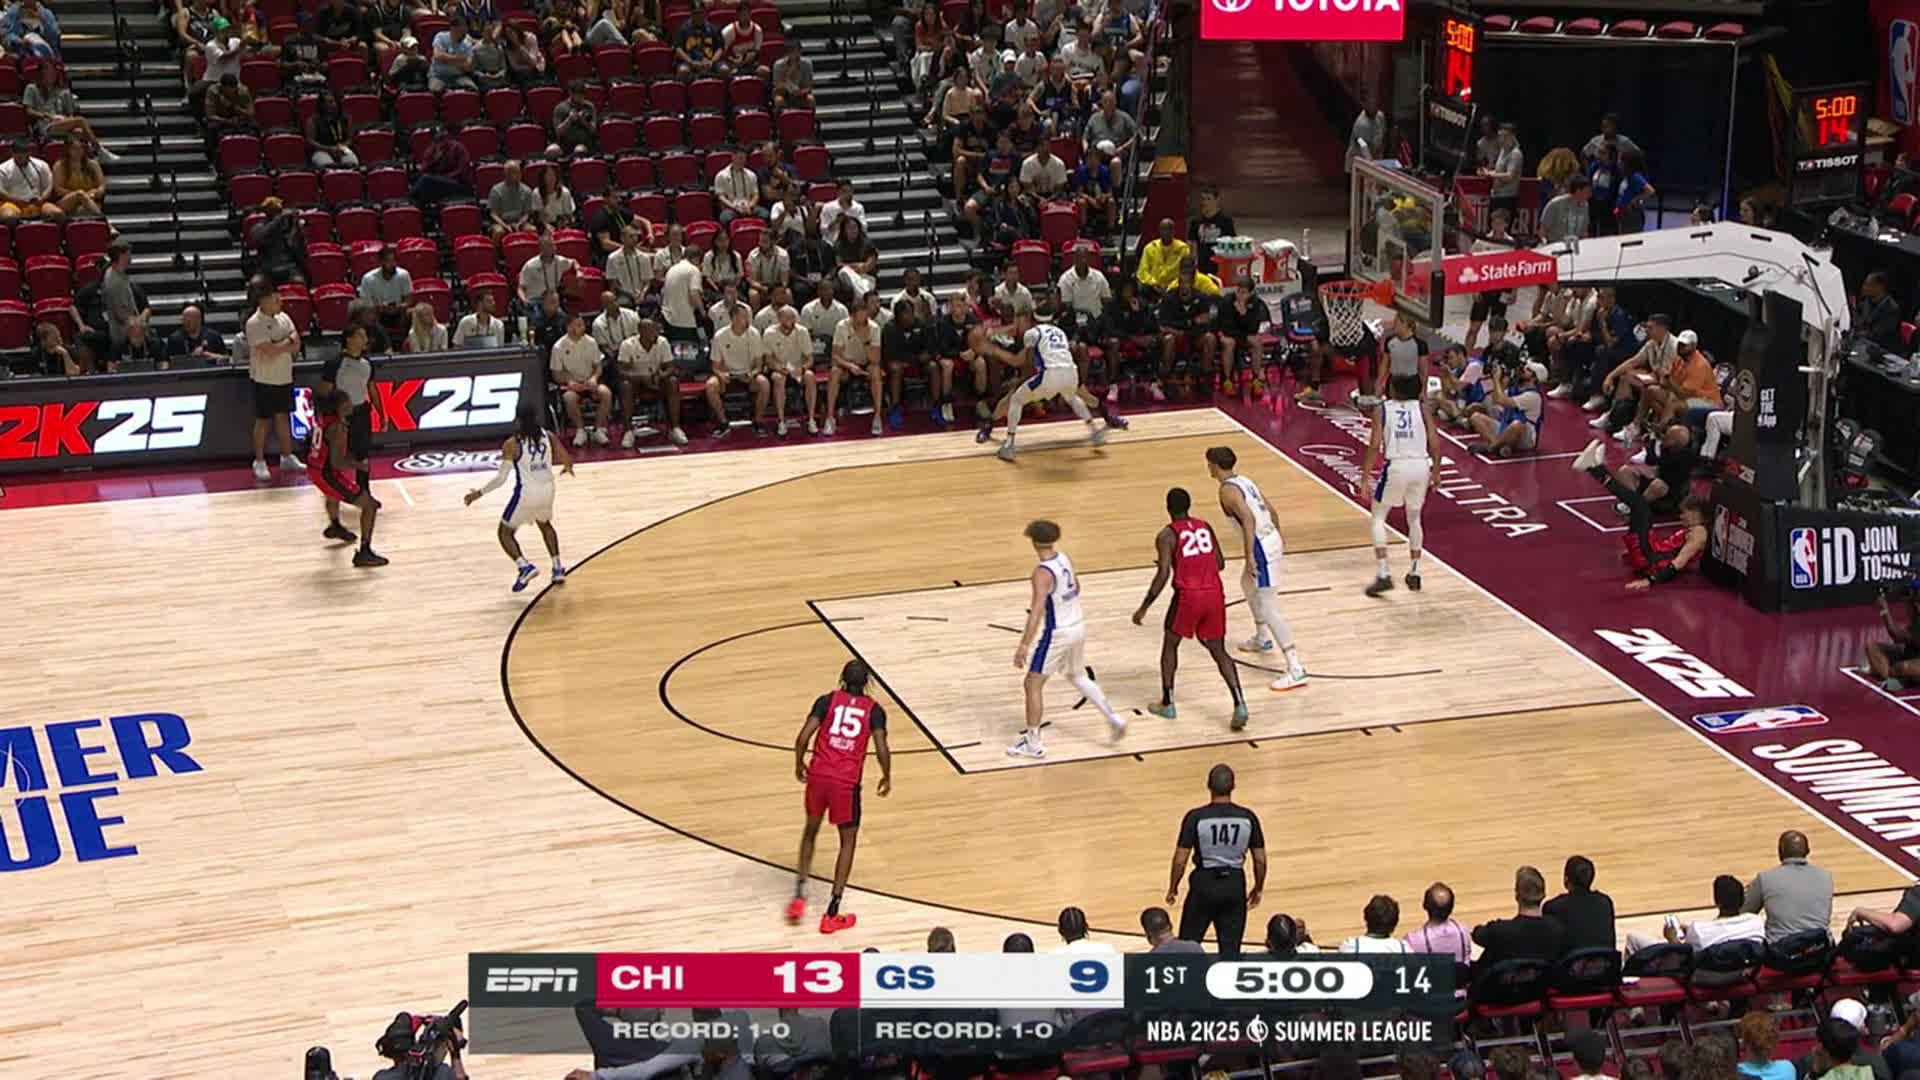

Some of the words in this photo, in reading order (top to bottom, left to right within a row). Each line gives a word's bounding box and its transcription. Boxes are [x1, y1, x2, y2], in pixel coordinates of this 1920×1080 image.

[1816, 96, 1857, 119] 5:00
[1819, 119, 1848, 145] 14
[1815, 155, 1859, 169] TISSOT
[371, 372, 523, 433] K25
[0, 394, 208, 460] 2K25
[1395, 410, 1412, 430] 31
[528, 442, 547, 461] 99
[1179, 528, 1214, 557] 28
[1860, 526, 1898, 553] JOIN
[1593, 628, 1756, 698] 2K25
[828, 705, 865, 738] 15
[1210, 824, 1240, 846] 147
